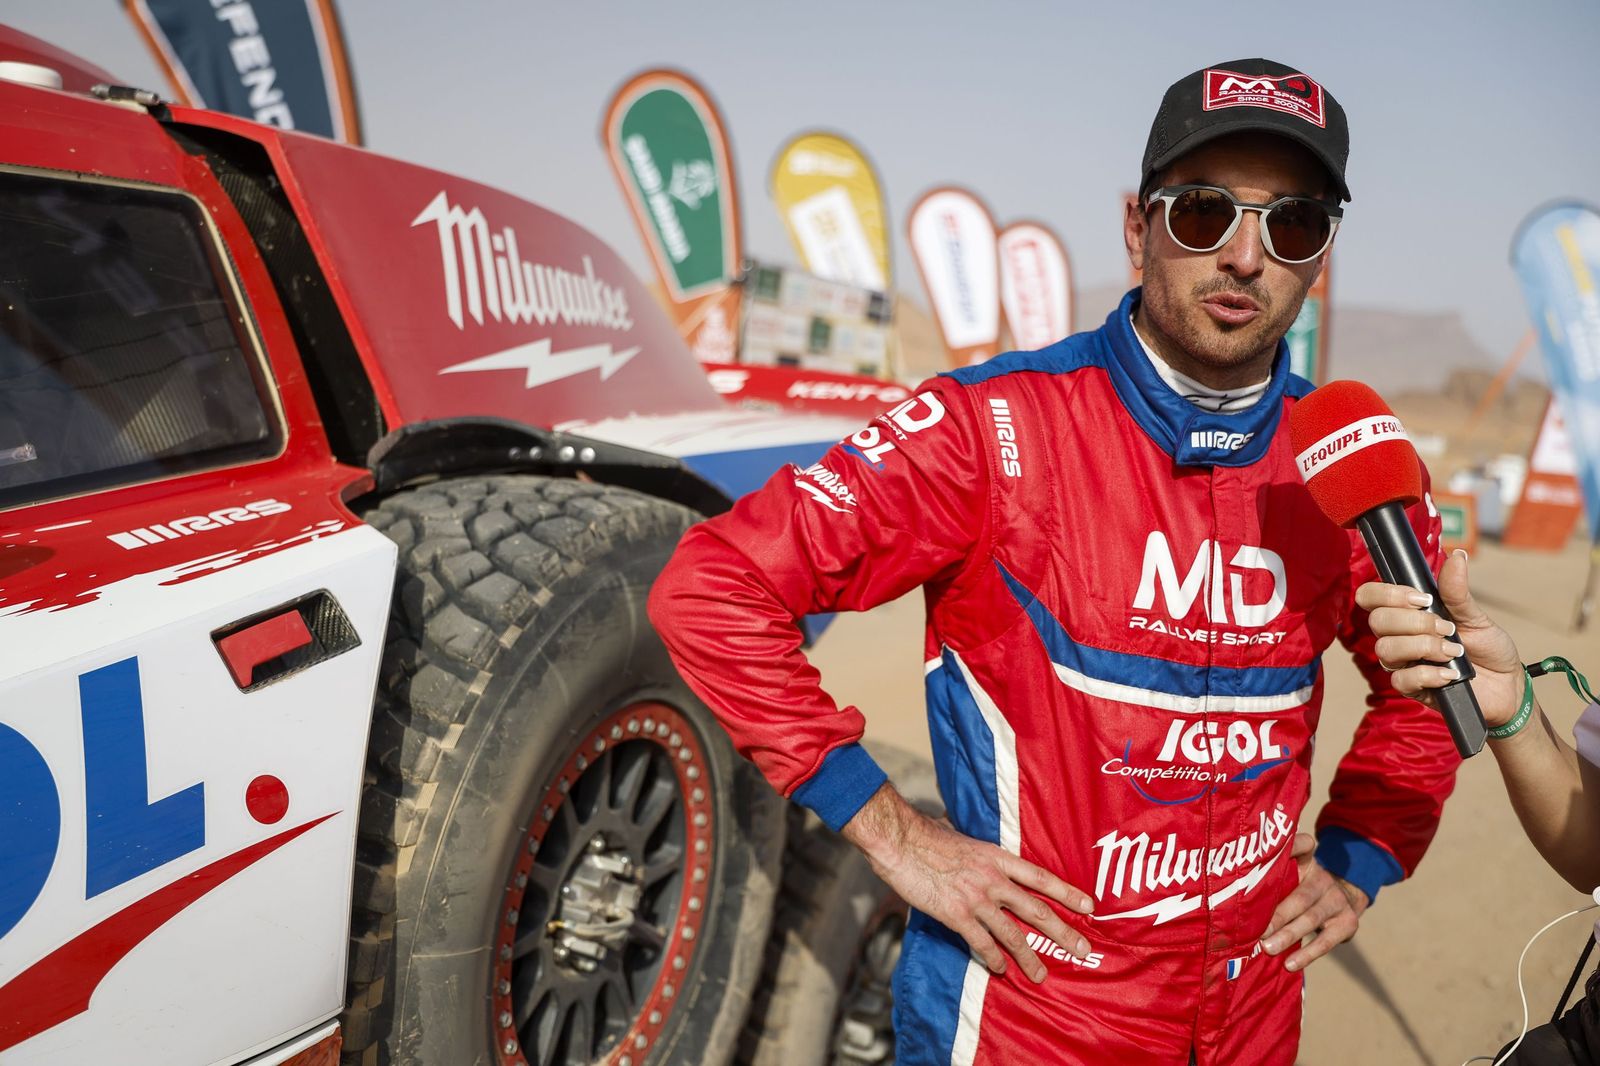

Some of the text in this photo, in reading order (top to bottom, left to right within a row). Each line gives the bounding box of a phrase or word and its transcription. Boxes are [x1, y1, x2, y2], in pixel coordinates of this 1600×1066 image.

[1219, 89, 1312, 109] RALLYE SPORT
[1274, 98, 1299, 111] 2003
[410, 191, 634, 331] Milwaukee
[1132, 530, 1287, 627] MD
[1222, 630, 1287, 646] SPORT
[1092, 813, 1293, 902] Milwaukee
